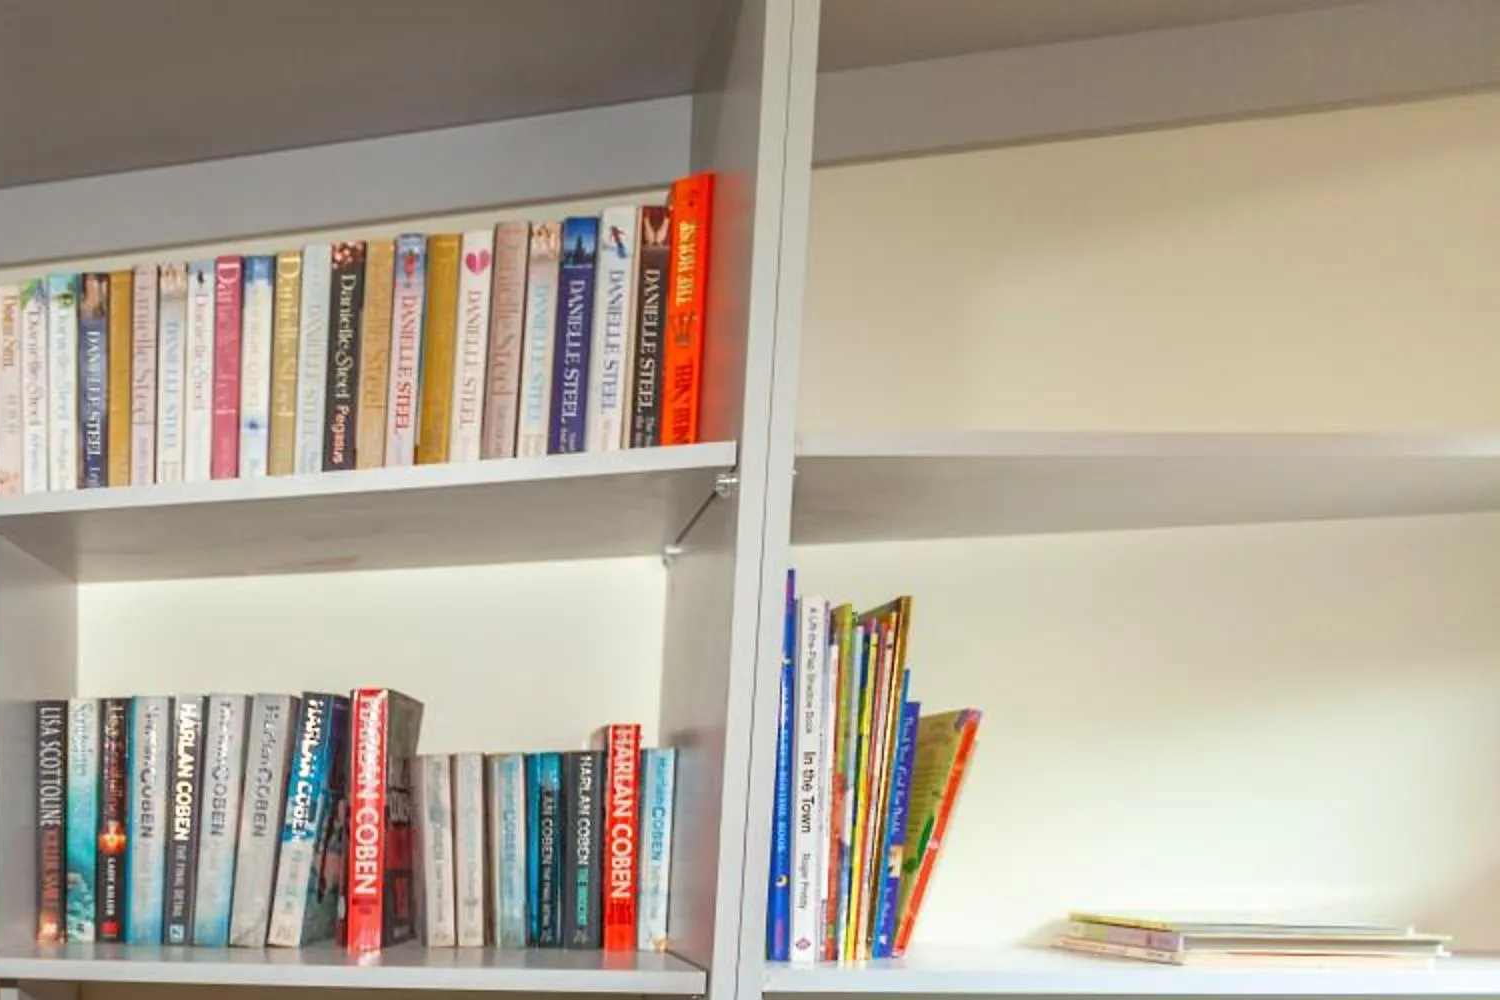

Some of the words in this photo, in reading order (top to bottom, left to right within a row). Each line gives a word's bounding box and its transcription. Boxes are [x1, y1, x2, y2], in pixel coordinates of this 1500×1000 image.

[338, 274, 356, 349] Danielle
[399, 296, 417, 377] DANIELLE
[464, 291, 482, 371] DANIELLE
[564, 279, 587, 365] DANIELLE
[605, 270, 625, 355] DANIELLE
[640, 269, 661, 353] DANIELLE
[335, 350, 352, 398] Steel
[490, 333, 517, 397] Steel
[601, 359, 620, 415] STEEL
[637, 358, 656, 412] STEEL
[395, 381, 413, 434] STEEL
[460, 376, 477, 429] STEEL
[561, 368, 580, 424] STEEL
[86, 410, 101, 459] STEEL
[332, 405, 349, 464] Pegasus
[39, 706, 62, 736] LISA
[176, 703, 196, 777] HARLAN
[40, 740, 63, 826] SCOTTOLINE
[577, 755, 592, 814] HARLAN
[612, 728, 635, 818] HARLAN
[801, 768, 815, 792] the
[802, 751, 816, 764] In
[173, 781, 192, 841] COBEN
[800, 796, 814, 834] Town
[355, 806, 378, 895] COBEN
[576, 818, 590, 866] COBEN
[610, 823, 632, 898] COBEN
